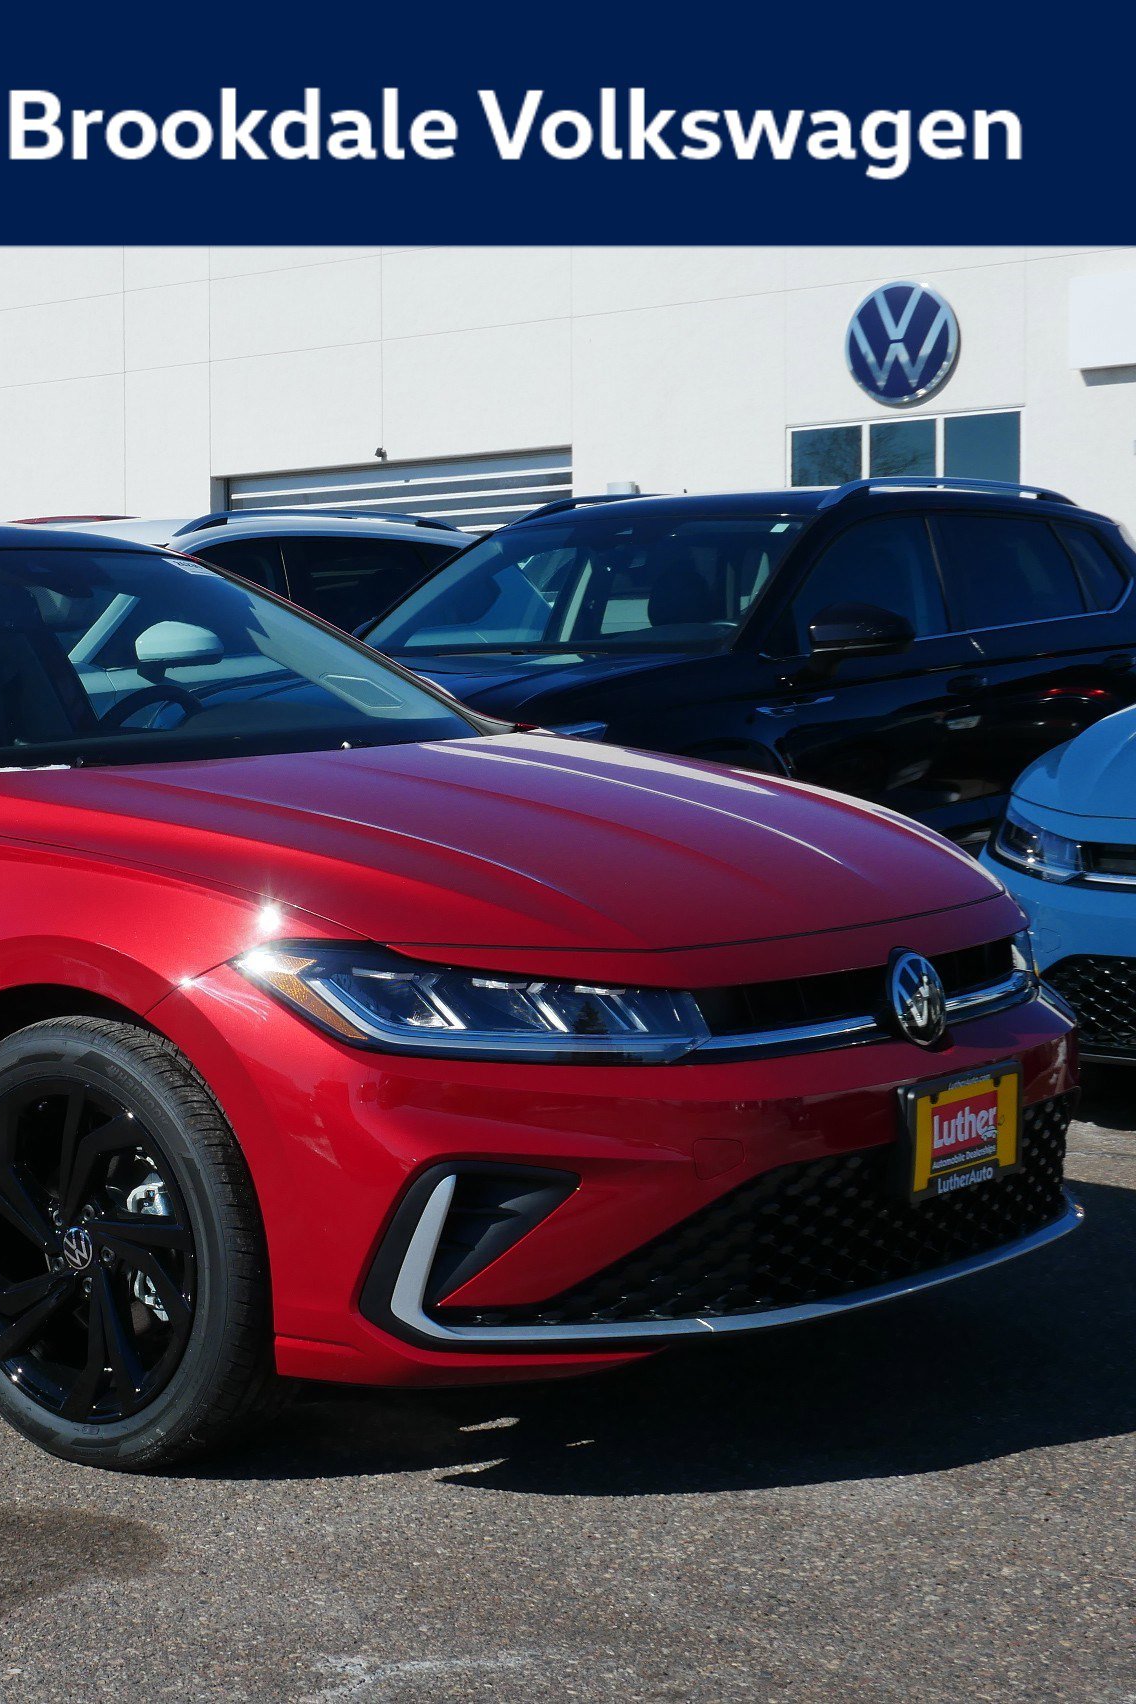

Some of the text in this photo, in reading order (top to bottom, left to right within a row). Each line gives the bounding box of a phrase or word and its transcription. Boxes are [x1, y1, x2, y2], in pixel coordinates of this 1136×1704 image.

[933, 1105, 997, 1149] Luther
[932, 1153, 966, 1170] Automobile
[937, 1165, 994, 1194] LutherAuto
